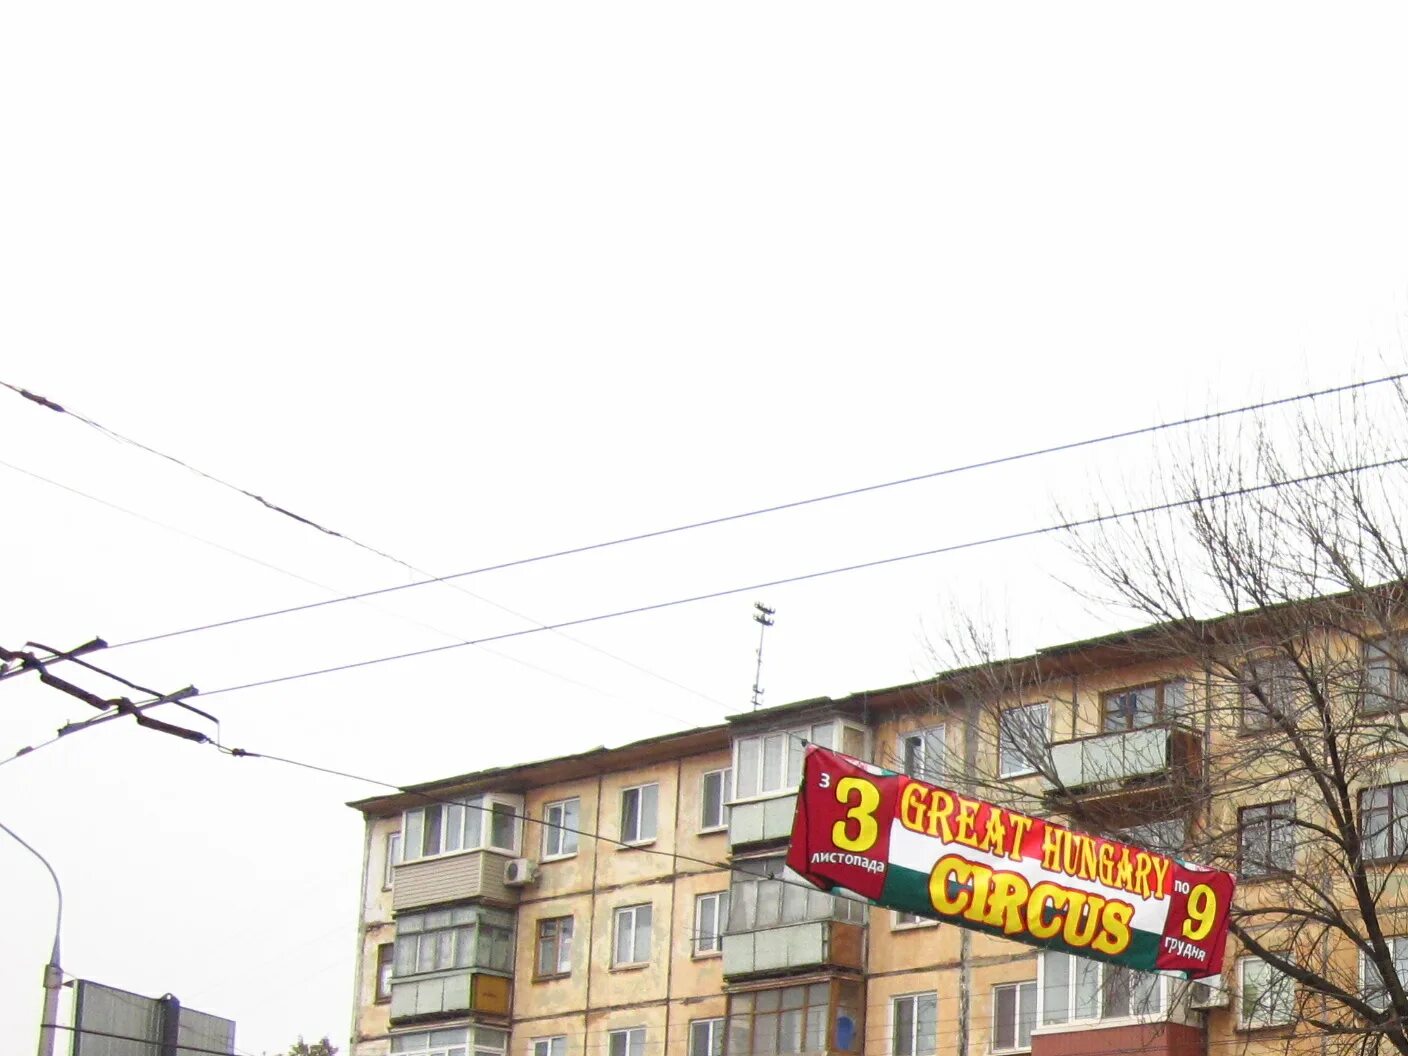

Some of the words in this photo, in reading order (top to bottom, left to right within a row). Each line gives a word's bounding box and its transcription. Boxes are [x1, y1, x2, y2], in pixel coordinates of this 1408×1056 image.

[832, 776, 880, 852] 3
[900, 782, 1033, 862] GREAT
[1041, 822, 1170, 900] HUNGARY
[811, 852, 885, 874] листопада
[1174, 880, 1190, 894] по
[929, 854, 1134, 955] CIRCUS
[1182, 884, 1217, 940] 9
[1165, 936, 1206, 962] грудня
